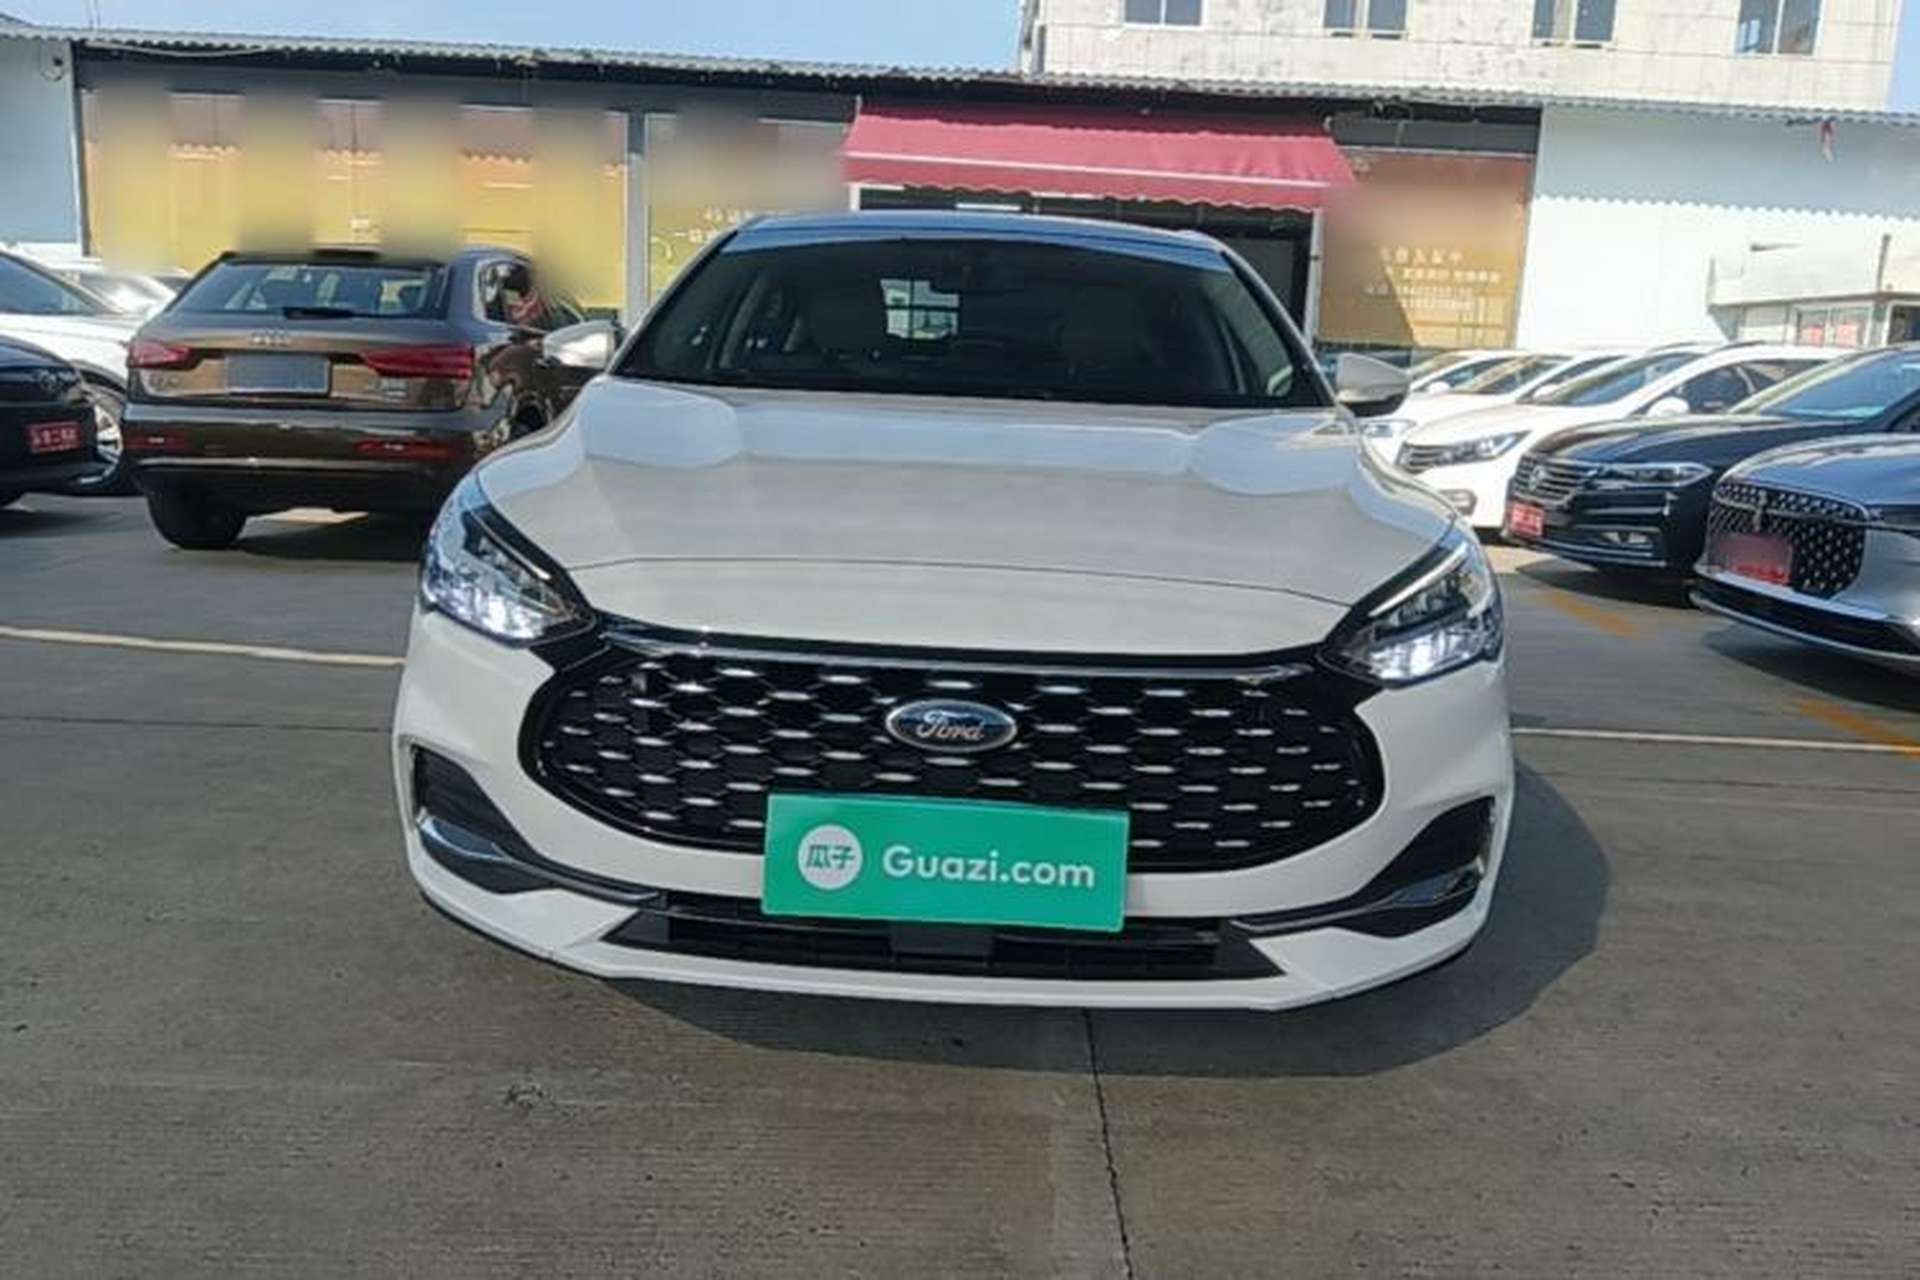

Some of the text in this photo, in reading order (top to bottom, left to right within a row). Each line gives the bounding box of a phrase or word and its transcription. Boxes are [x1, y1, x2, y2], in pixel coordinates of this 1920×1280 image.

[916, 710, 984, 741] Ford
[805, 843, 857, 870] 瓜子
[883, 845, 1095, 888] Guazi.com
